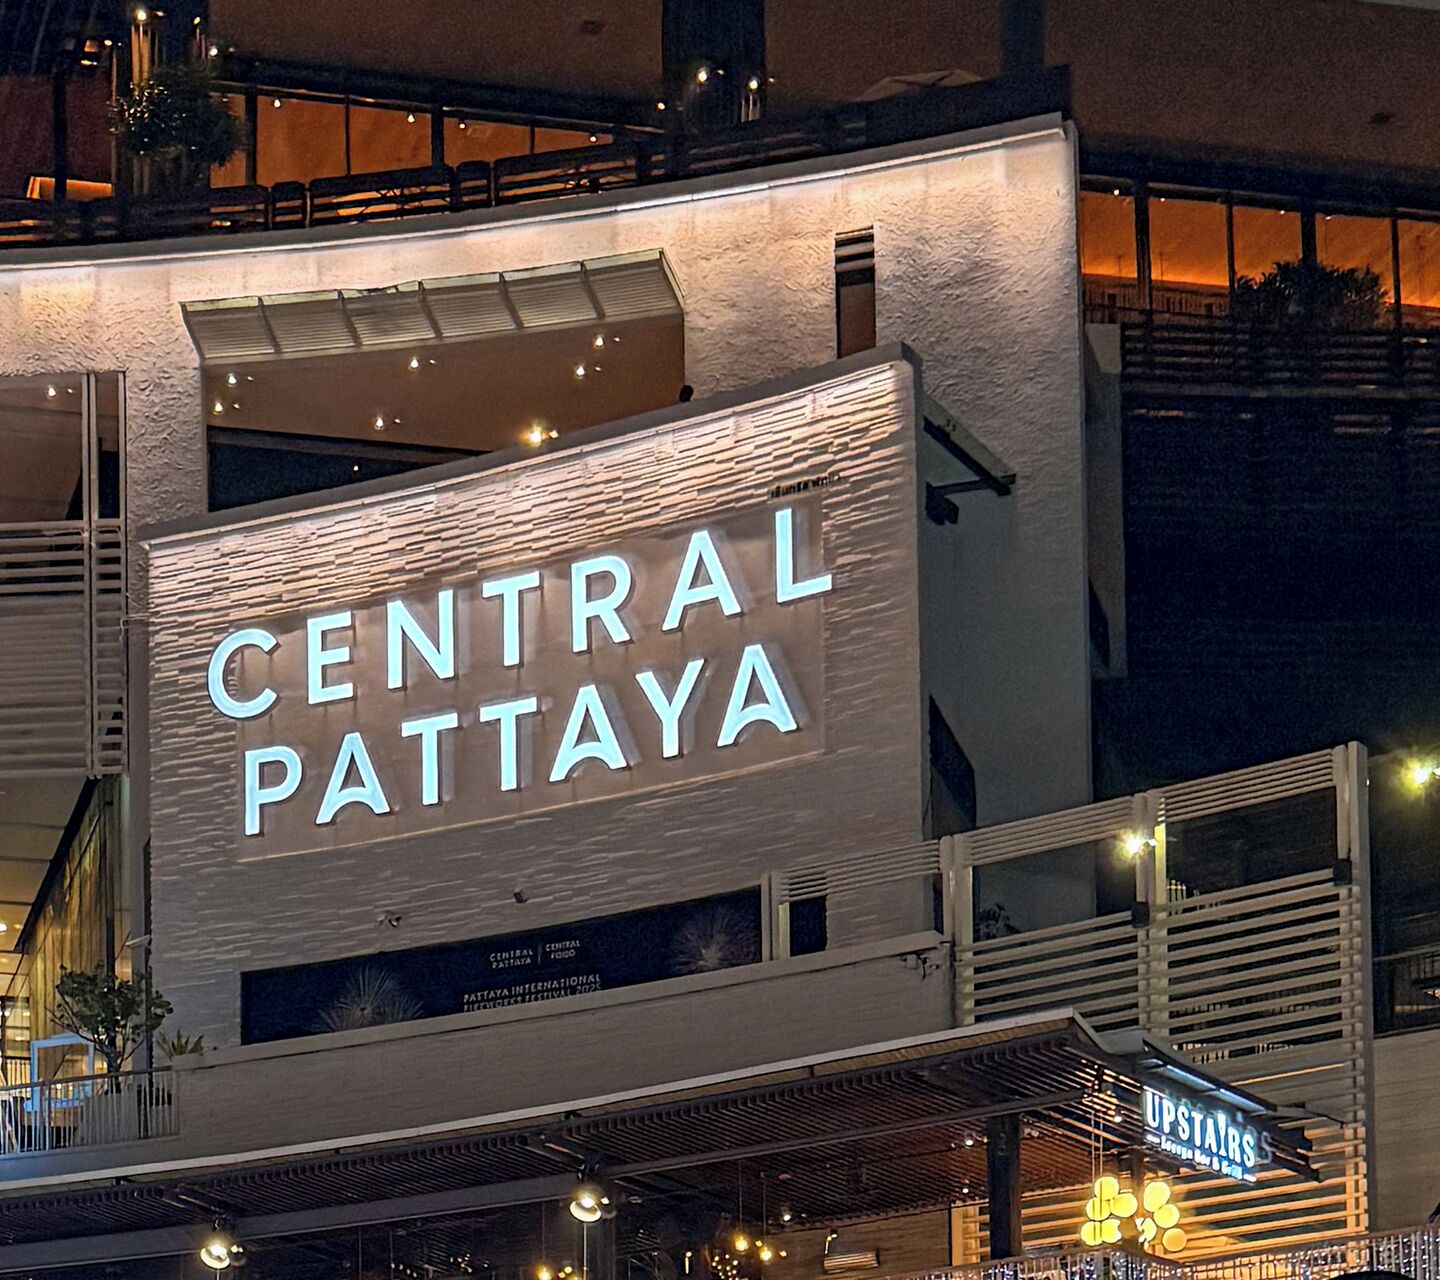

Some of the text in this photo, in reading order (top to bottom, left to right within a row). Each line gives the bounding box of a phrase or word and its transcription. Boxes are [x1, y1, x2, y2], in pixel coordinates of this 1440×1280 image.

[207, 507, 832, 720] CENTRAL
[244, 644, 798, 836] PATTAYA
[490, 948, 534, 962] CENTRAL
[545, 940, 580, 952] CENTRAL
[492, 957, 532, 969] PATTAYA
[463, 973, 601, 1003] PATTAYA INTERNATIONAL
[1145, 1090, 1255, 1168] UPSTAIRS
